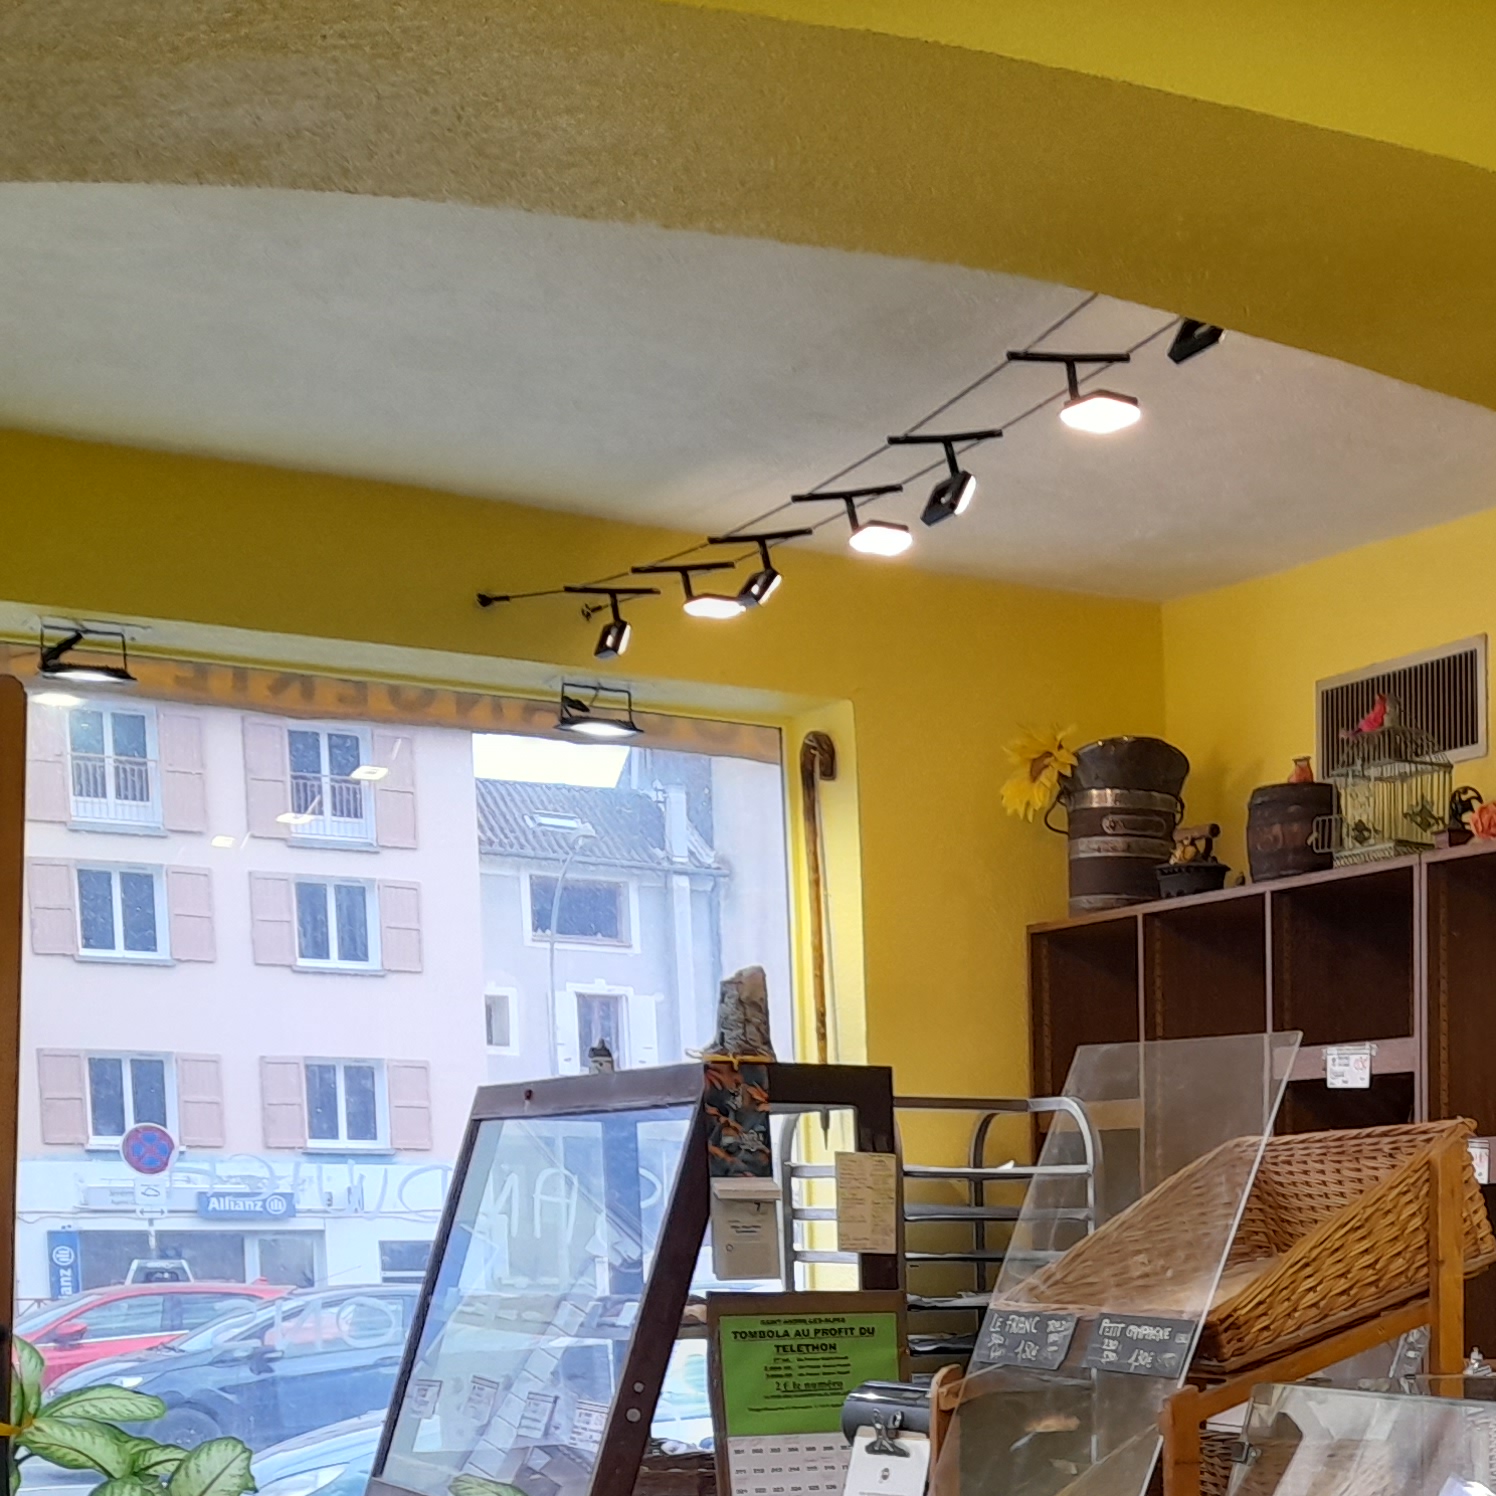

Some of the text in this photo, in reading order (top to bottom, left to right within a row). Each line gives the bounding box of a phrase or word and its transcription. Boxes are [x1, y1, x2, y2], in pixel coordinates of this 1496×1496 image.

[208, 1195, 263, 1212] Allianz
[731, 1326, 875, 1340] TOMBOLA AU PROFIT DU
[774, 1343, 837, 1353] TELETHON
